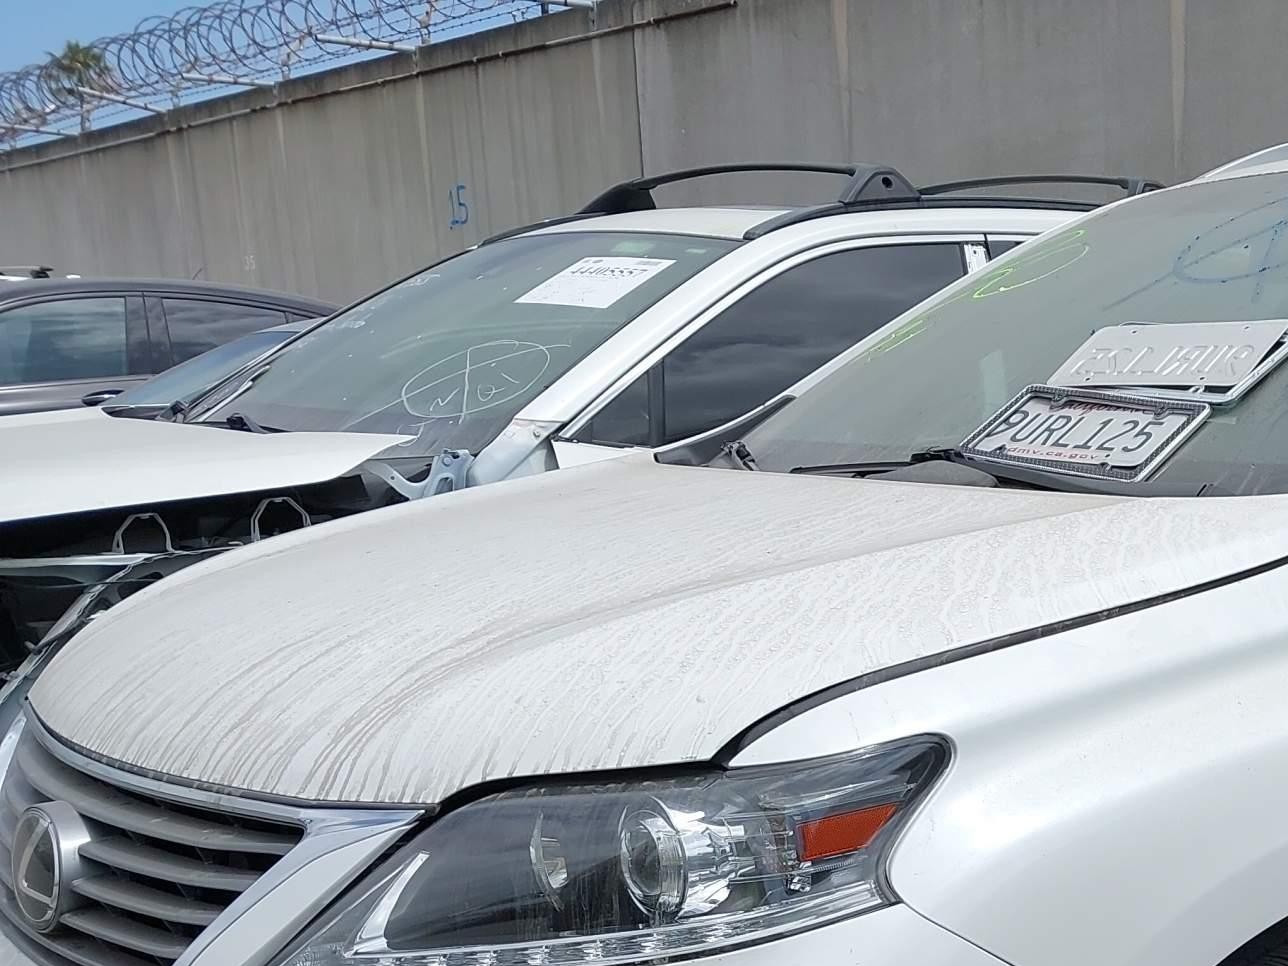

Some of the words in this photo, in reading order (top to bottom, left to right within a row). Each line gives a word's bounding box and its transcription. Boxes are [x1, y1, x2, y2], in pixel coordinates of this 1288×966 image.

[447, 183, 470, 229] 15
[986, 409, 1165, 453] 9URL125
[1008, 446, 1099, 460] dmv.ca.gov
